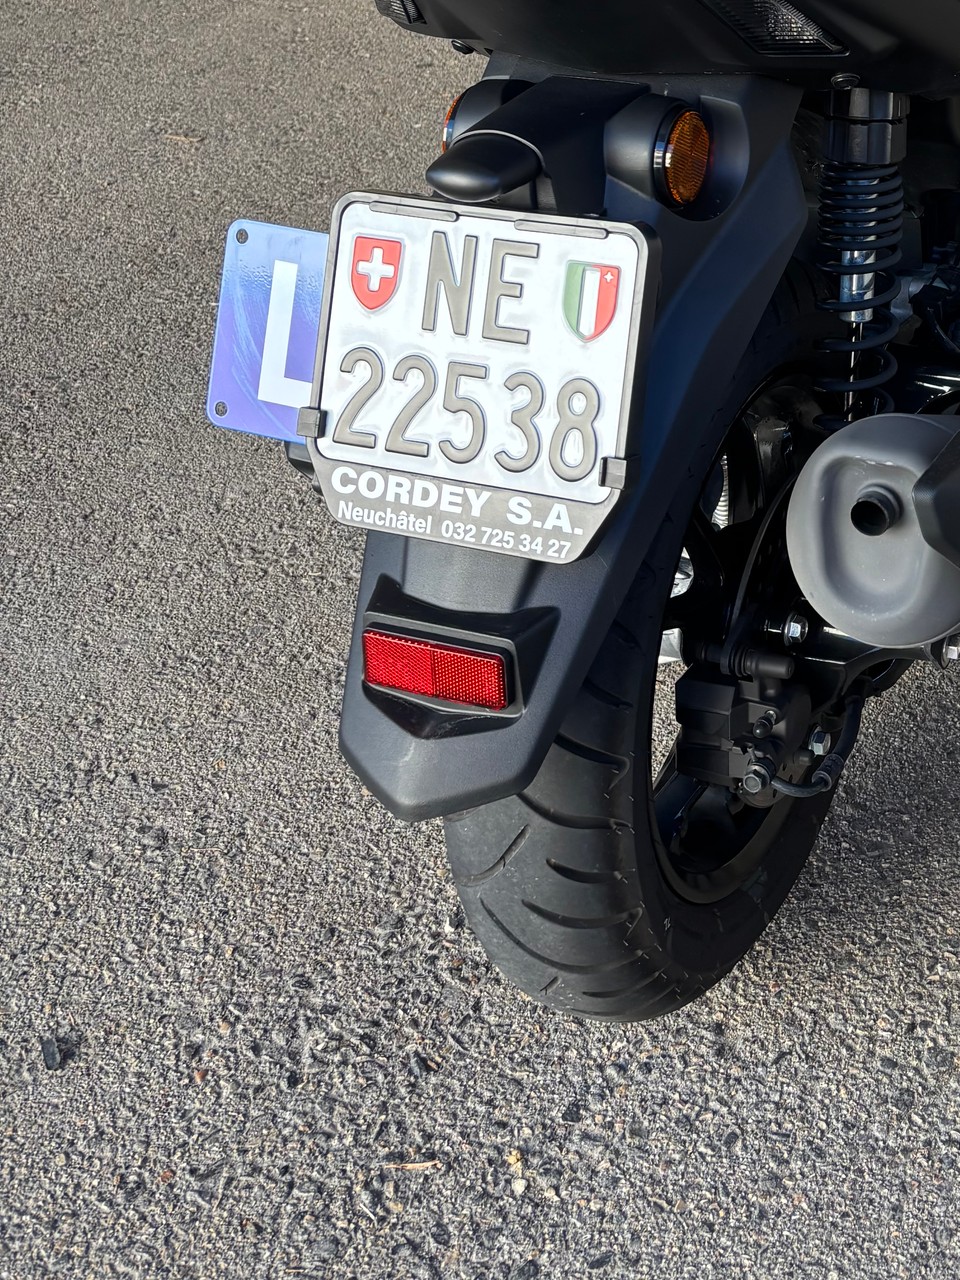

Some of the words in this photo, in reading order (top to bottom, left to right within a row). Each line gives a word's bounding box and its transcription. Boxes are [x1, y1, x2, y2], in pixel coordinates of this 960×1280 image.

[257, 260, 312, 407] L
[421, 230, 540, 344] NE
[332, 347, 601, 482] 22538
[331, 466, 492, 517] CORDEY
[506, 496, 584, 536] S.A.
[338, 501, 432, 534] Neuchâtel
[441, 520, 476, 541] 032
[481, 527, 515, 549] 725
[518, 533, 543, 555] 34
[547, 539, 571, 559] 27
